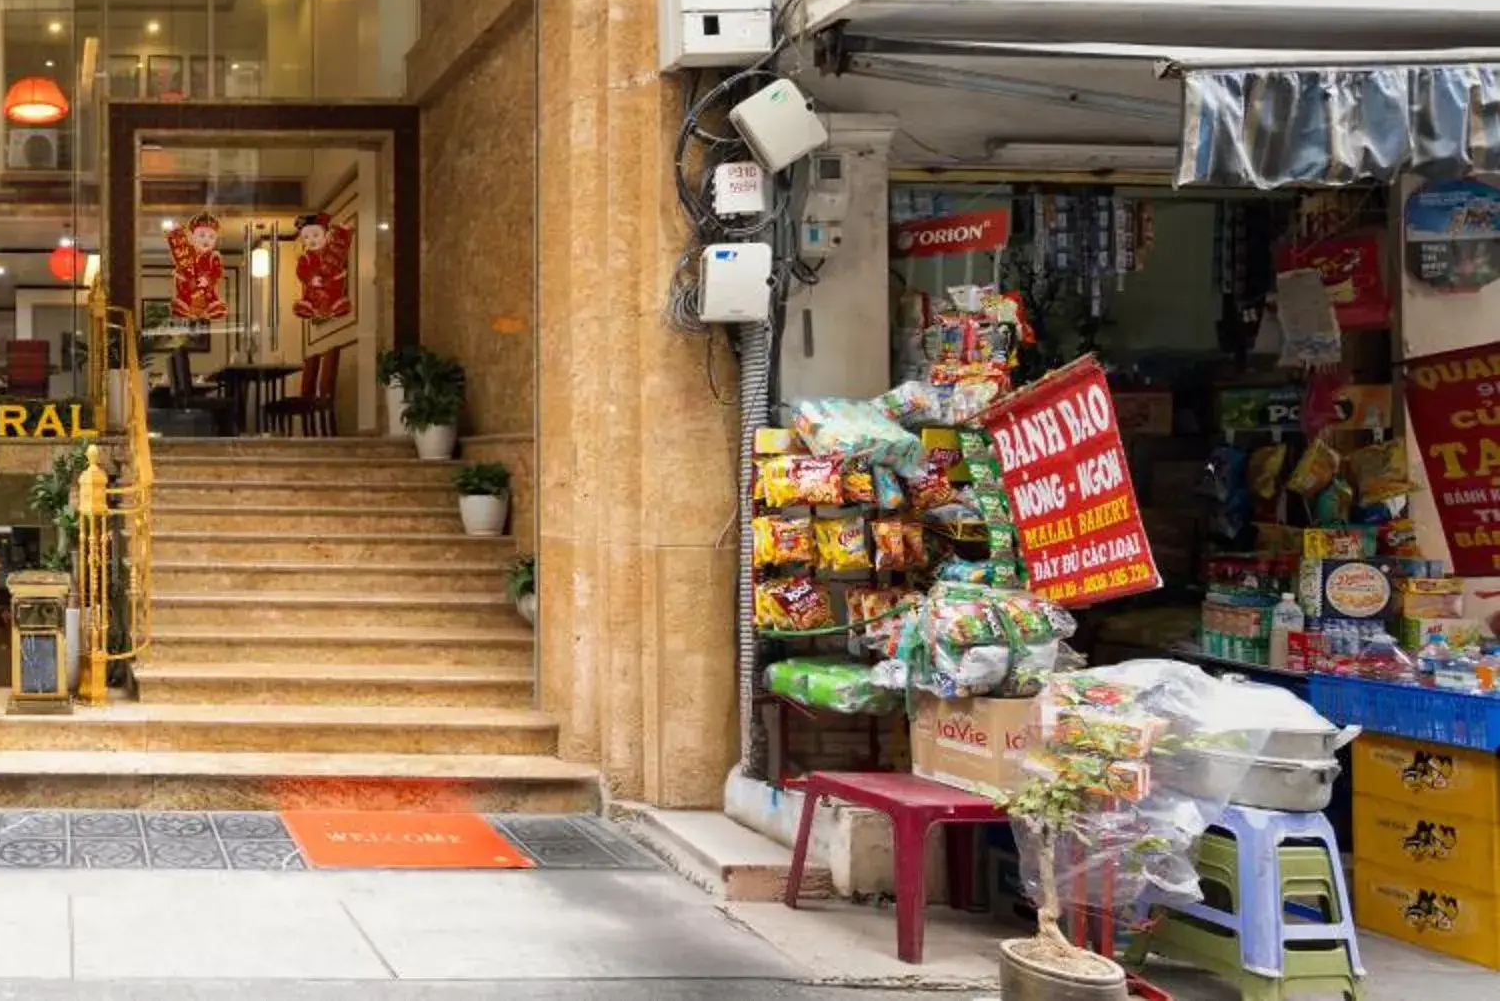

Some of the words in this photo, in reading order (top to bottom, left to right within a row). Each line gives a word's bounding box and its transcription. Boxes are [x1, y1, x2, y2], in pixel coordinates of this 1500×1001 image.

[917, 225, 983, 246] ORION
[994, 406, 1067, 472] BÁNH
[1056, 384, 1110, 446] BAO
[1076, 448, 1124, 500] NGON
[1024, 517, 1075, 550] MALAI
[1077, 495, 1130, 535] BAKERY
[937, 718, 988, 746] laVie
